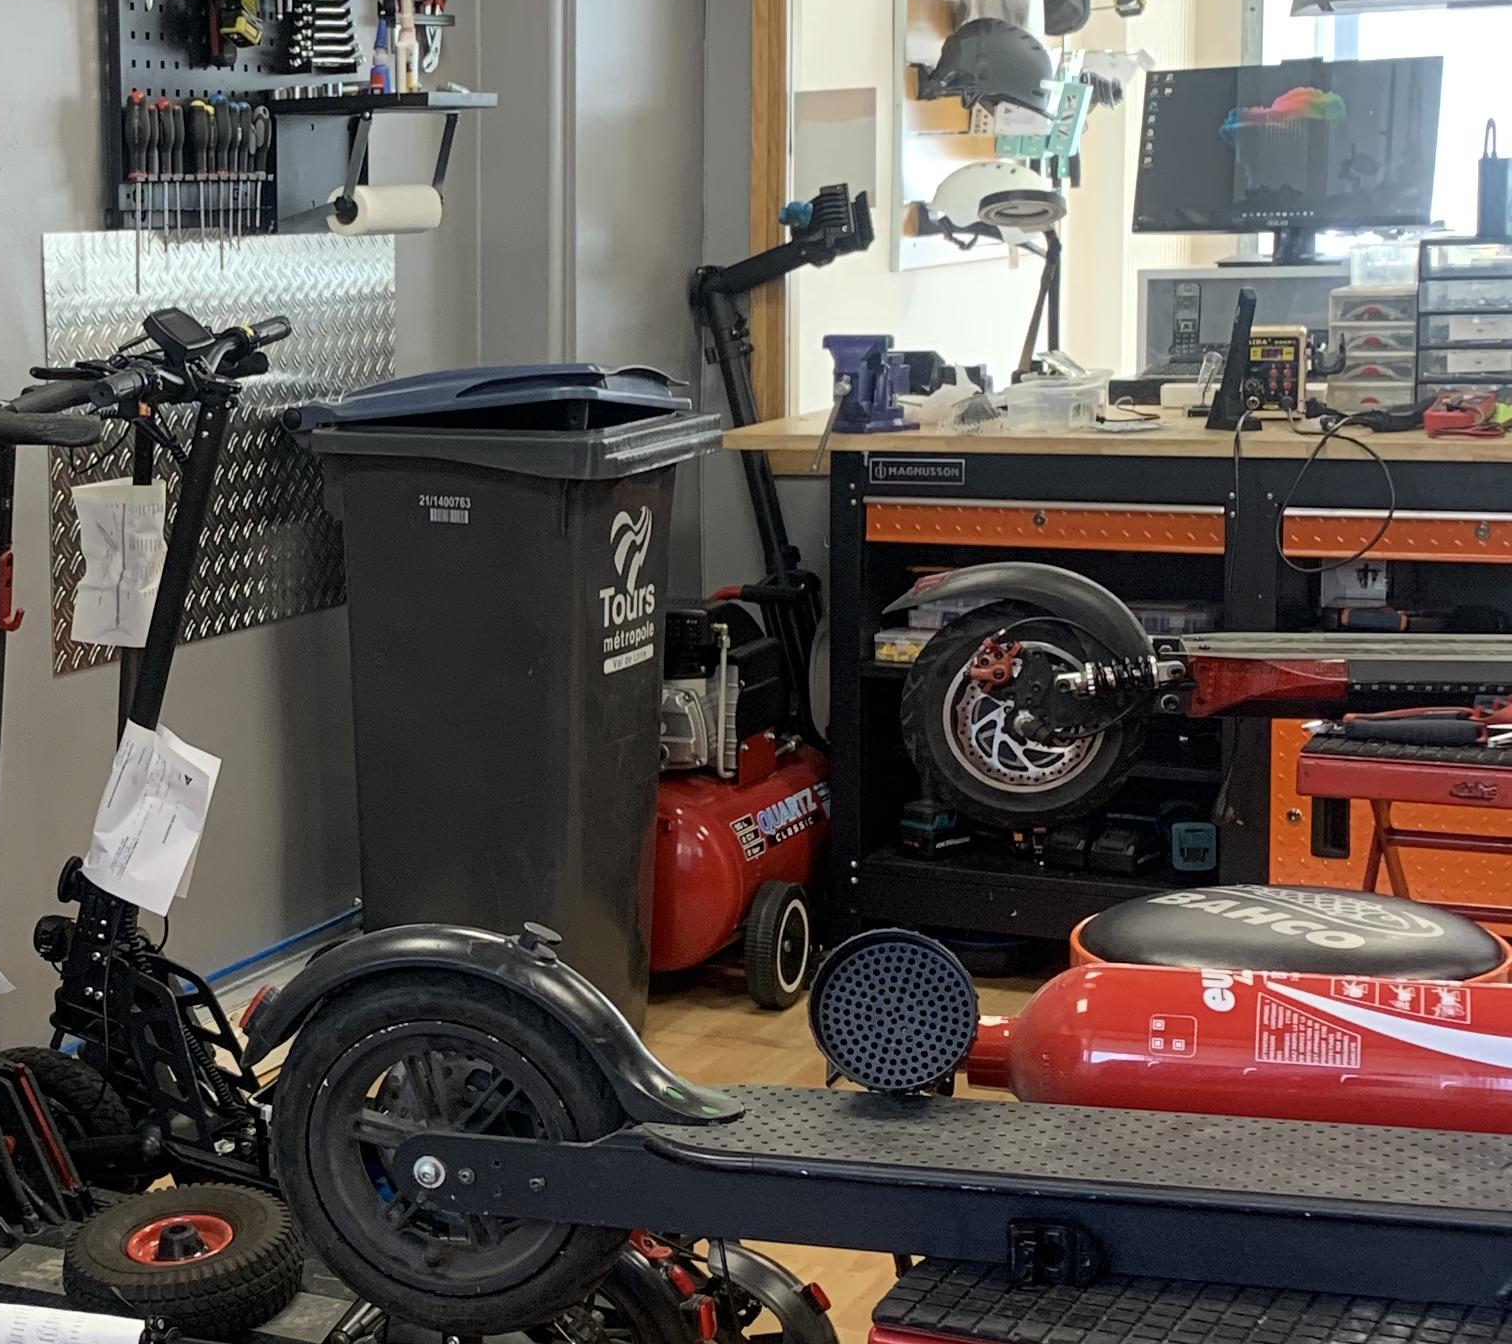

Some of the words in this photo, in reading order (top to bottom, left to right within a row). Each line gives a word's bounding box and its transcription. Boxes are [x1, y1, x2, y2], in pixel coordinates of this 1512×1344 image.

[888, 466, 960, 477] MAGNUSSON
[419, 494, 471, 509] 21/1400763
[599, 583, 656, 628] Tours
[603, 620, 655, 653] métropole
[757, 787, 818, 835] QUARTZ
[775, 816, 814, 843] CLASSIC
[1147, 892, 1366, 949] BAHCO
